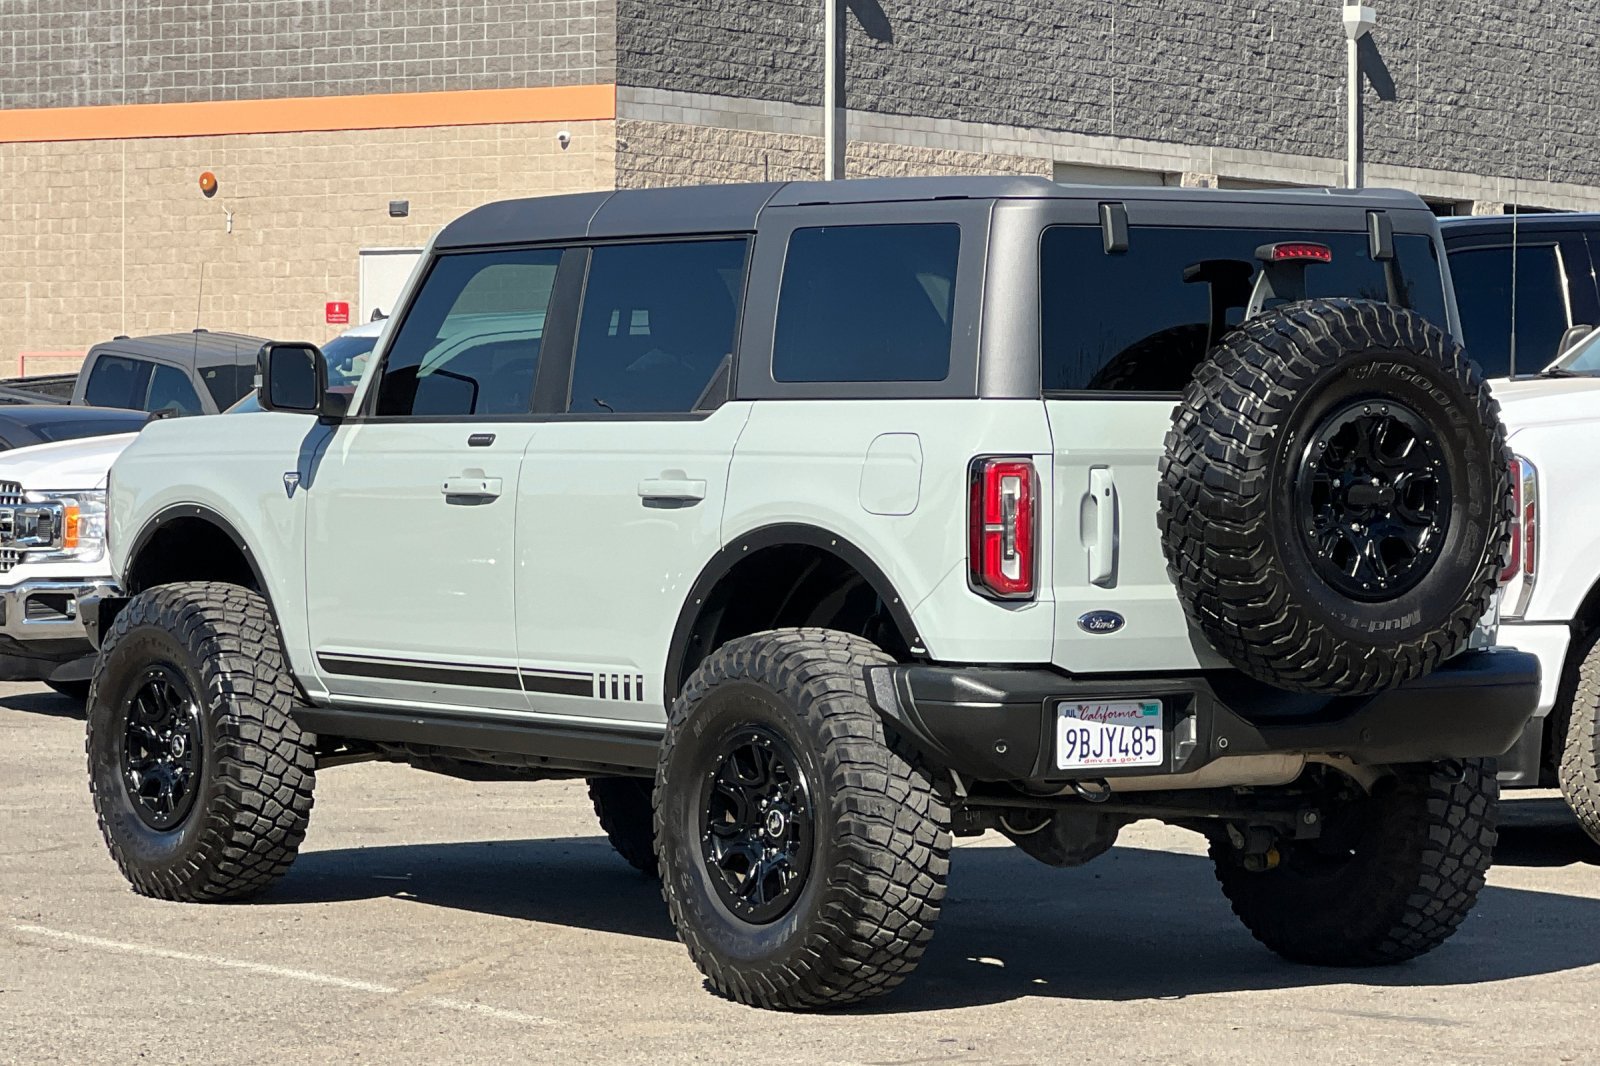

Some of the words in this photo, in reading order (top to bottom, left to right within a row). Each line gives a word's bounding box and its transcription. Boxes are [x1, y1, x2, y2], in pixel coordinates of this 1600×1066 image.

[1089, 616, 1115, 629] Ford
[1064, 709, 1076, 718] JUL
[1080, 705, 1144, 724] California
[1066, 725, 1156, 759] 9BJY485
[1083, 756, 1137, 764] dmv.ca.gov
